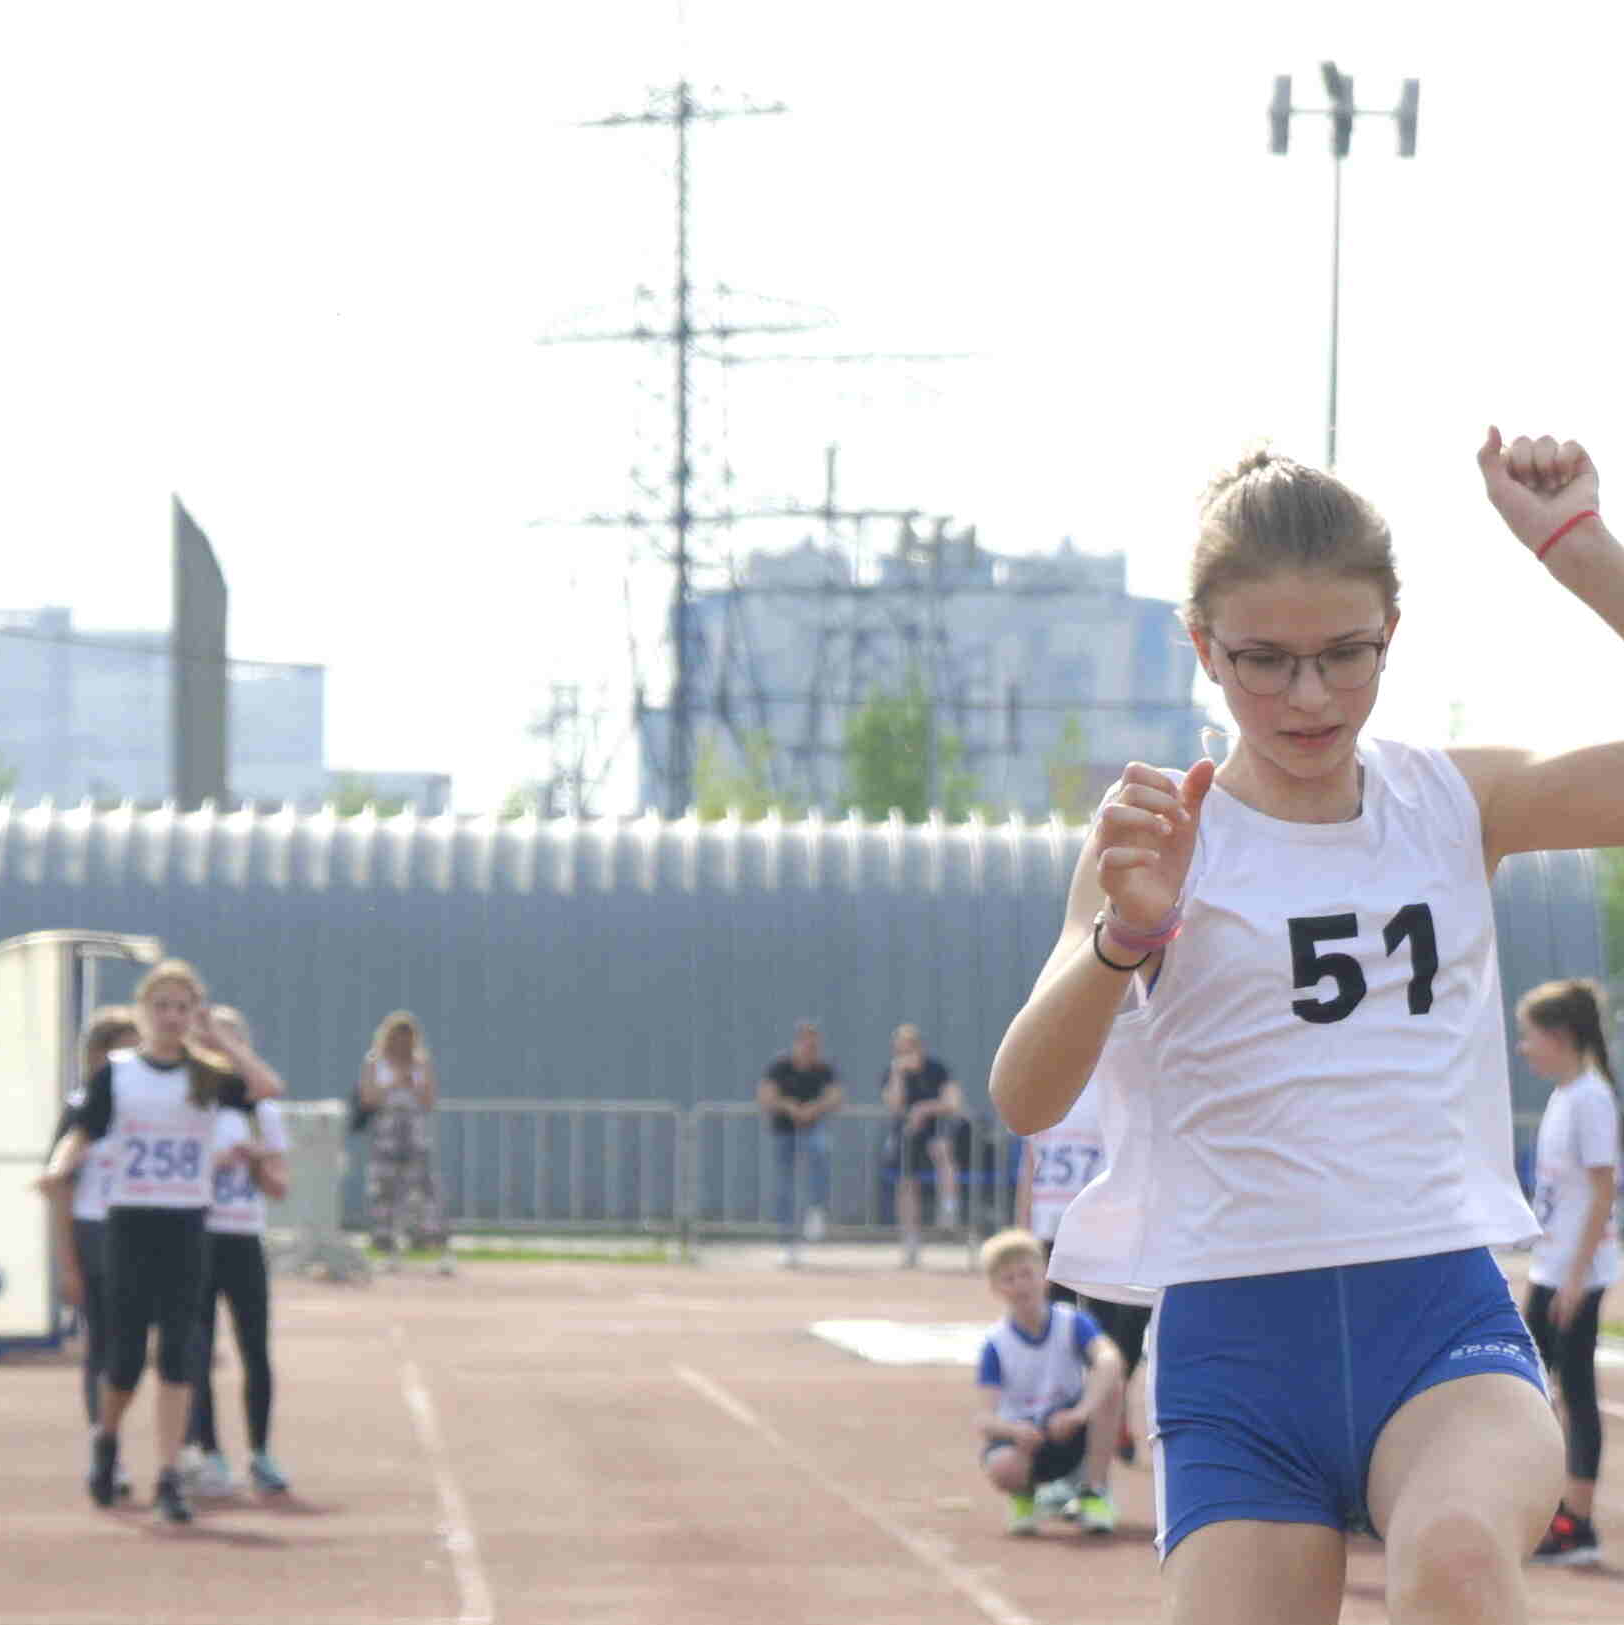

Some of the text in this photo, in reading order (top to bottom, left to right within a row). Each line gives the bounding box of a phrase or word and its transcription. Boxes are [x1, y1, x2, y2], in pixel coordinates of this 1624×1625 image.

[1287, 902, 1439, 1024] 51
[126, 1138, 202, 1179] 258
[1032, 1145, 1100, 1186] 257
